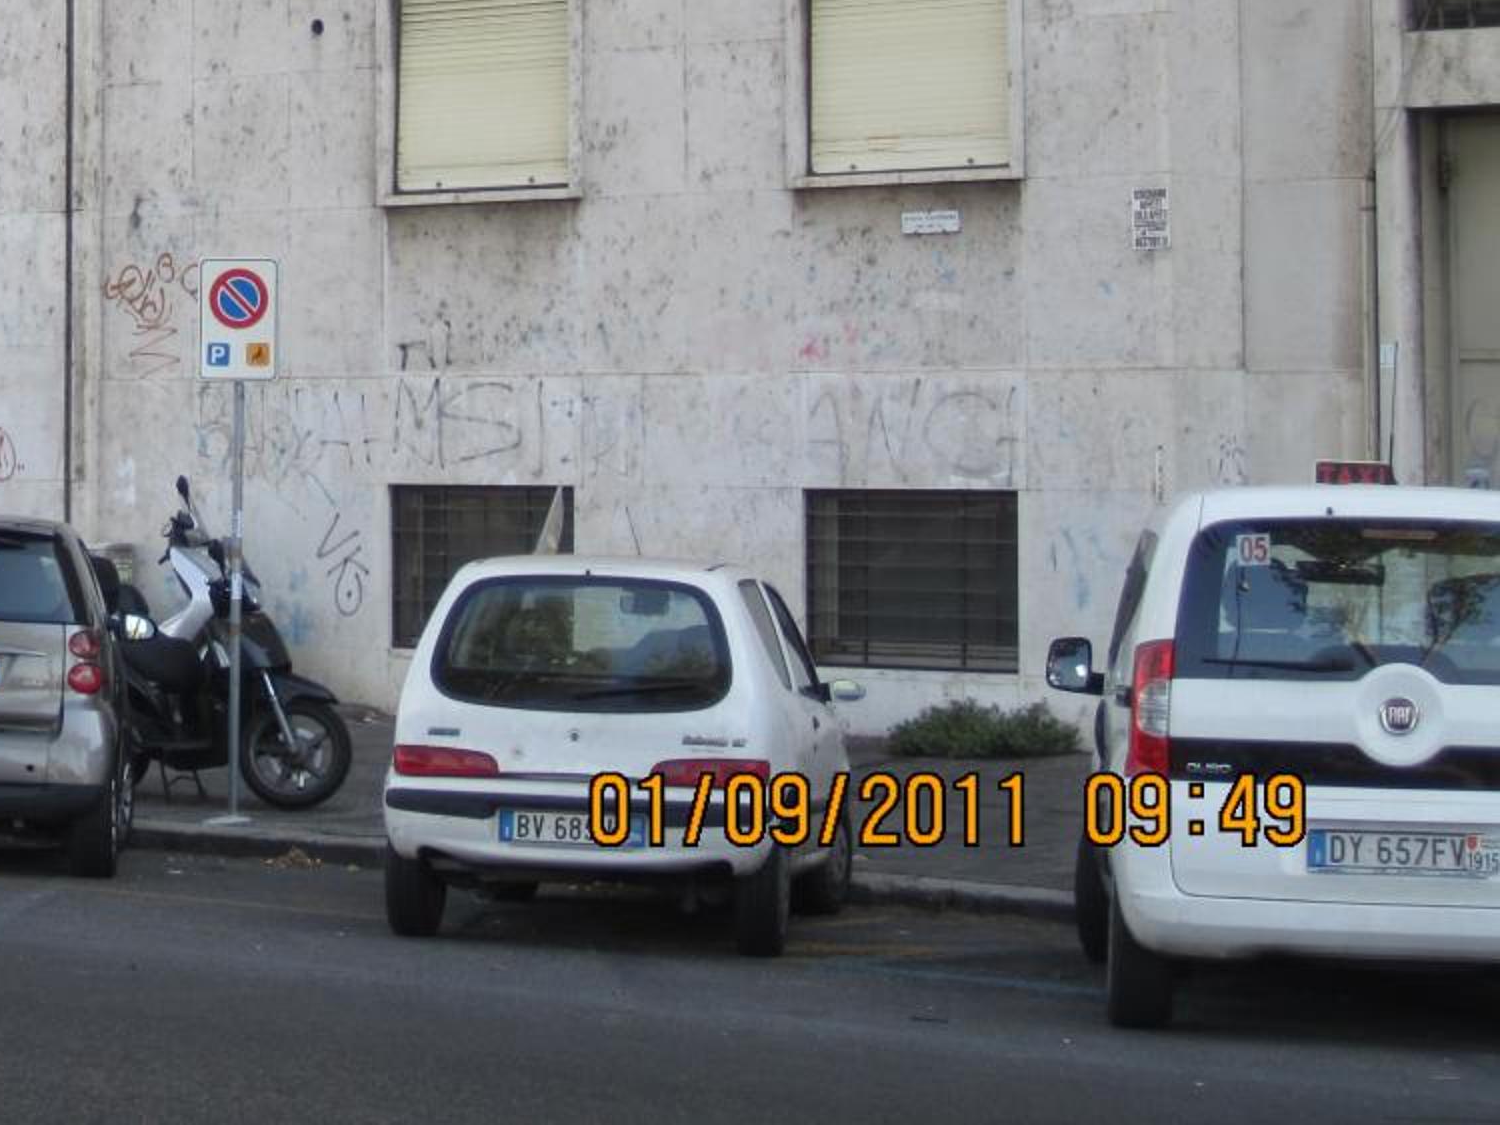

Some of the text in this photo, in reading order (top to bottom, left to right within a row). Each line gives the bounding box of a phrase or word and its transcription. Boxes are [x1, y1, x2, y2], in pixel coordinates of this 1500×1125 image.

[210, 346, 226, 364] P
[1239, 537, 1268, 563] 05
[516, 814, 546, 838] BV
[1329, 834, 1466, 867] DY 657FV
